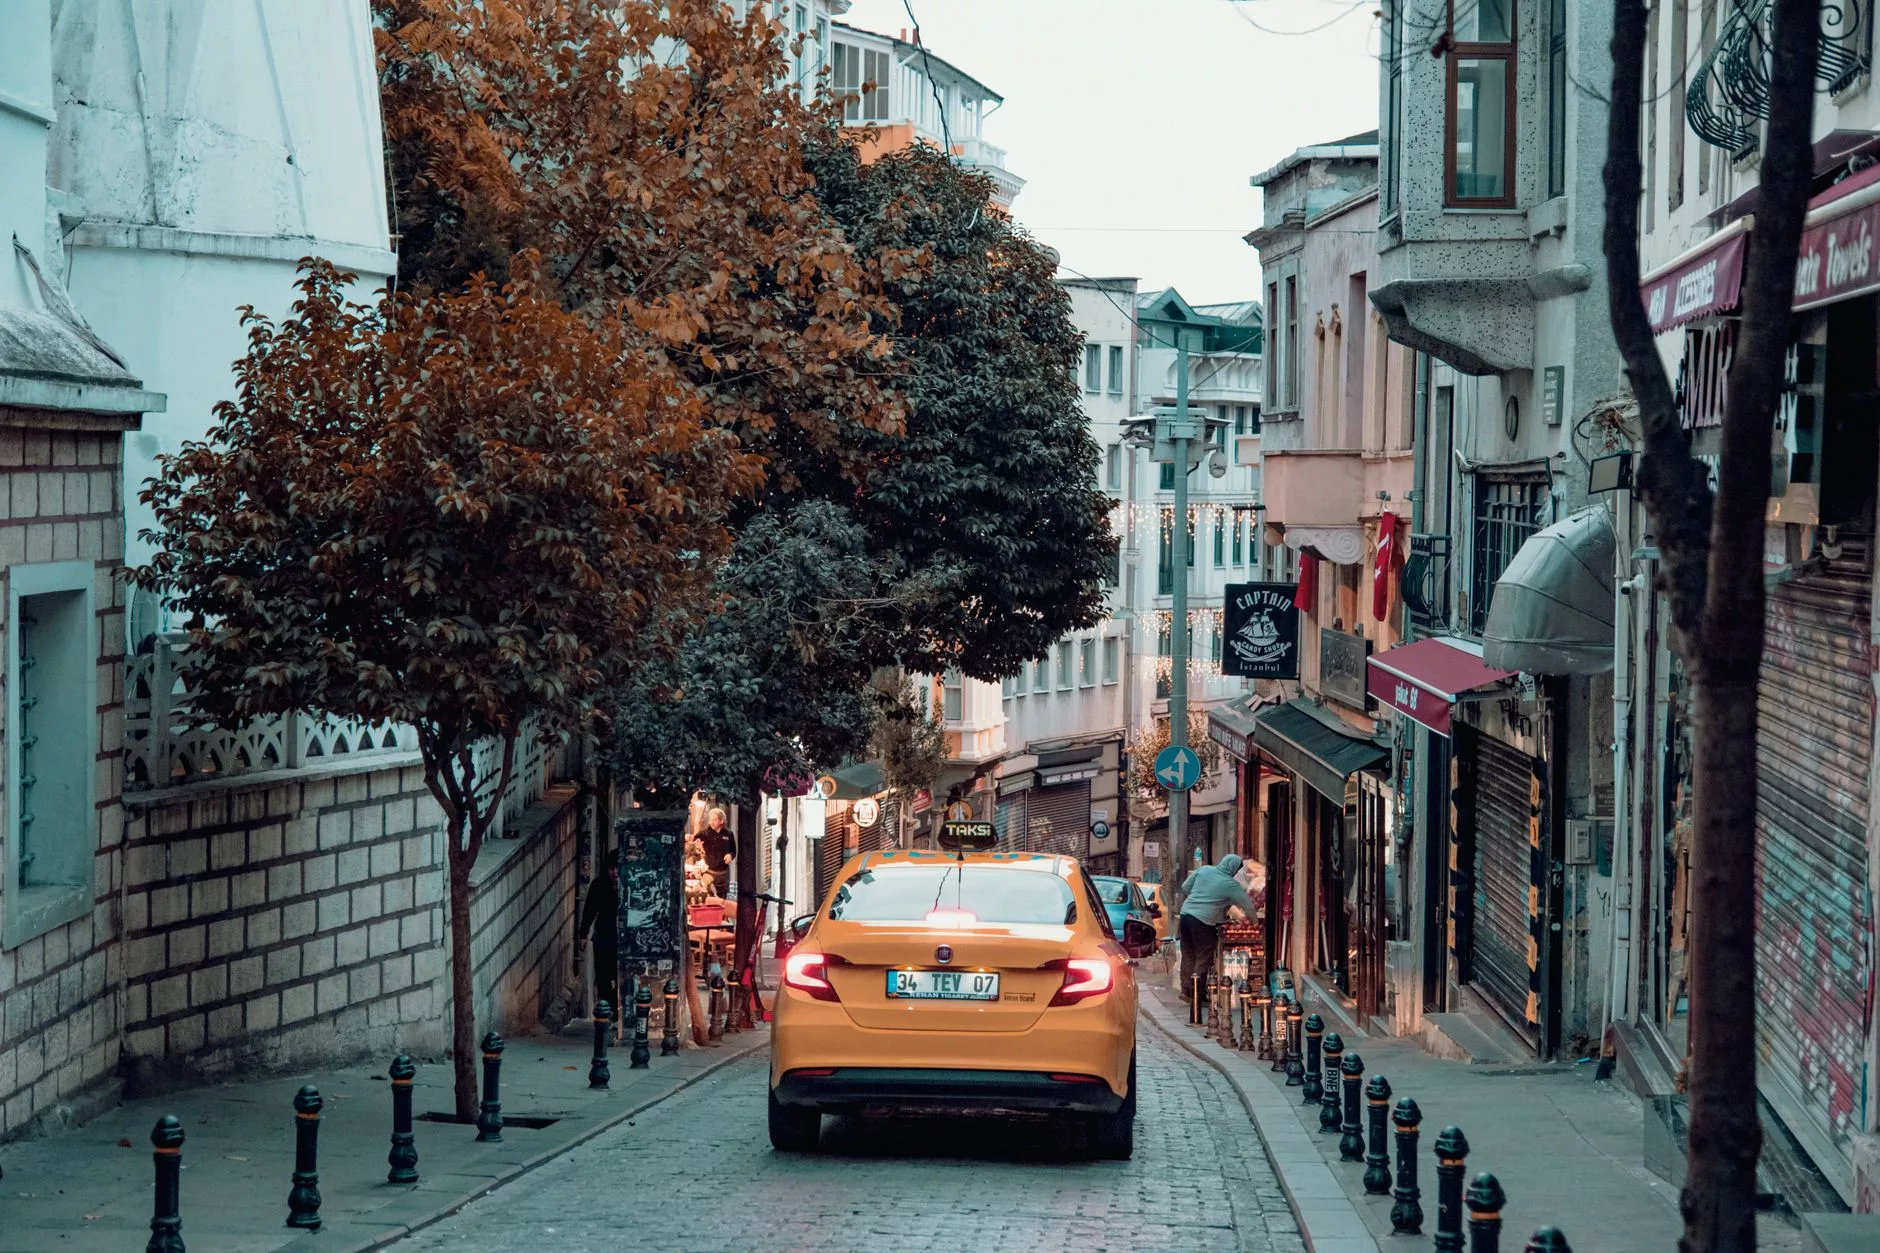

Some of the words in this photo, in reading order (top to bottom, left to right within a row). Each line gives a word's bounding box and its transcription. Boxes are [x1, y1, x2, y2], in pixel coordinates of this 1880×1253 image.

[1826, 220, 1872, 289] Towels
[1236, 590, 1292, 612] CAPTAIN
[1241, 641, 1262, 653] CANDY
[1263, 642, 1281, 653] SHOP
[897, 973, 918, 992] 34
[931, 973, 962, 992] TEV
[973, 975, 995, 993] 07
[1276, 1021, 1286, 1040] BNE
[1326, 1069, 1338, 1092] BNE
